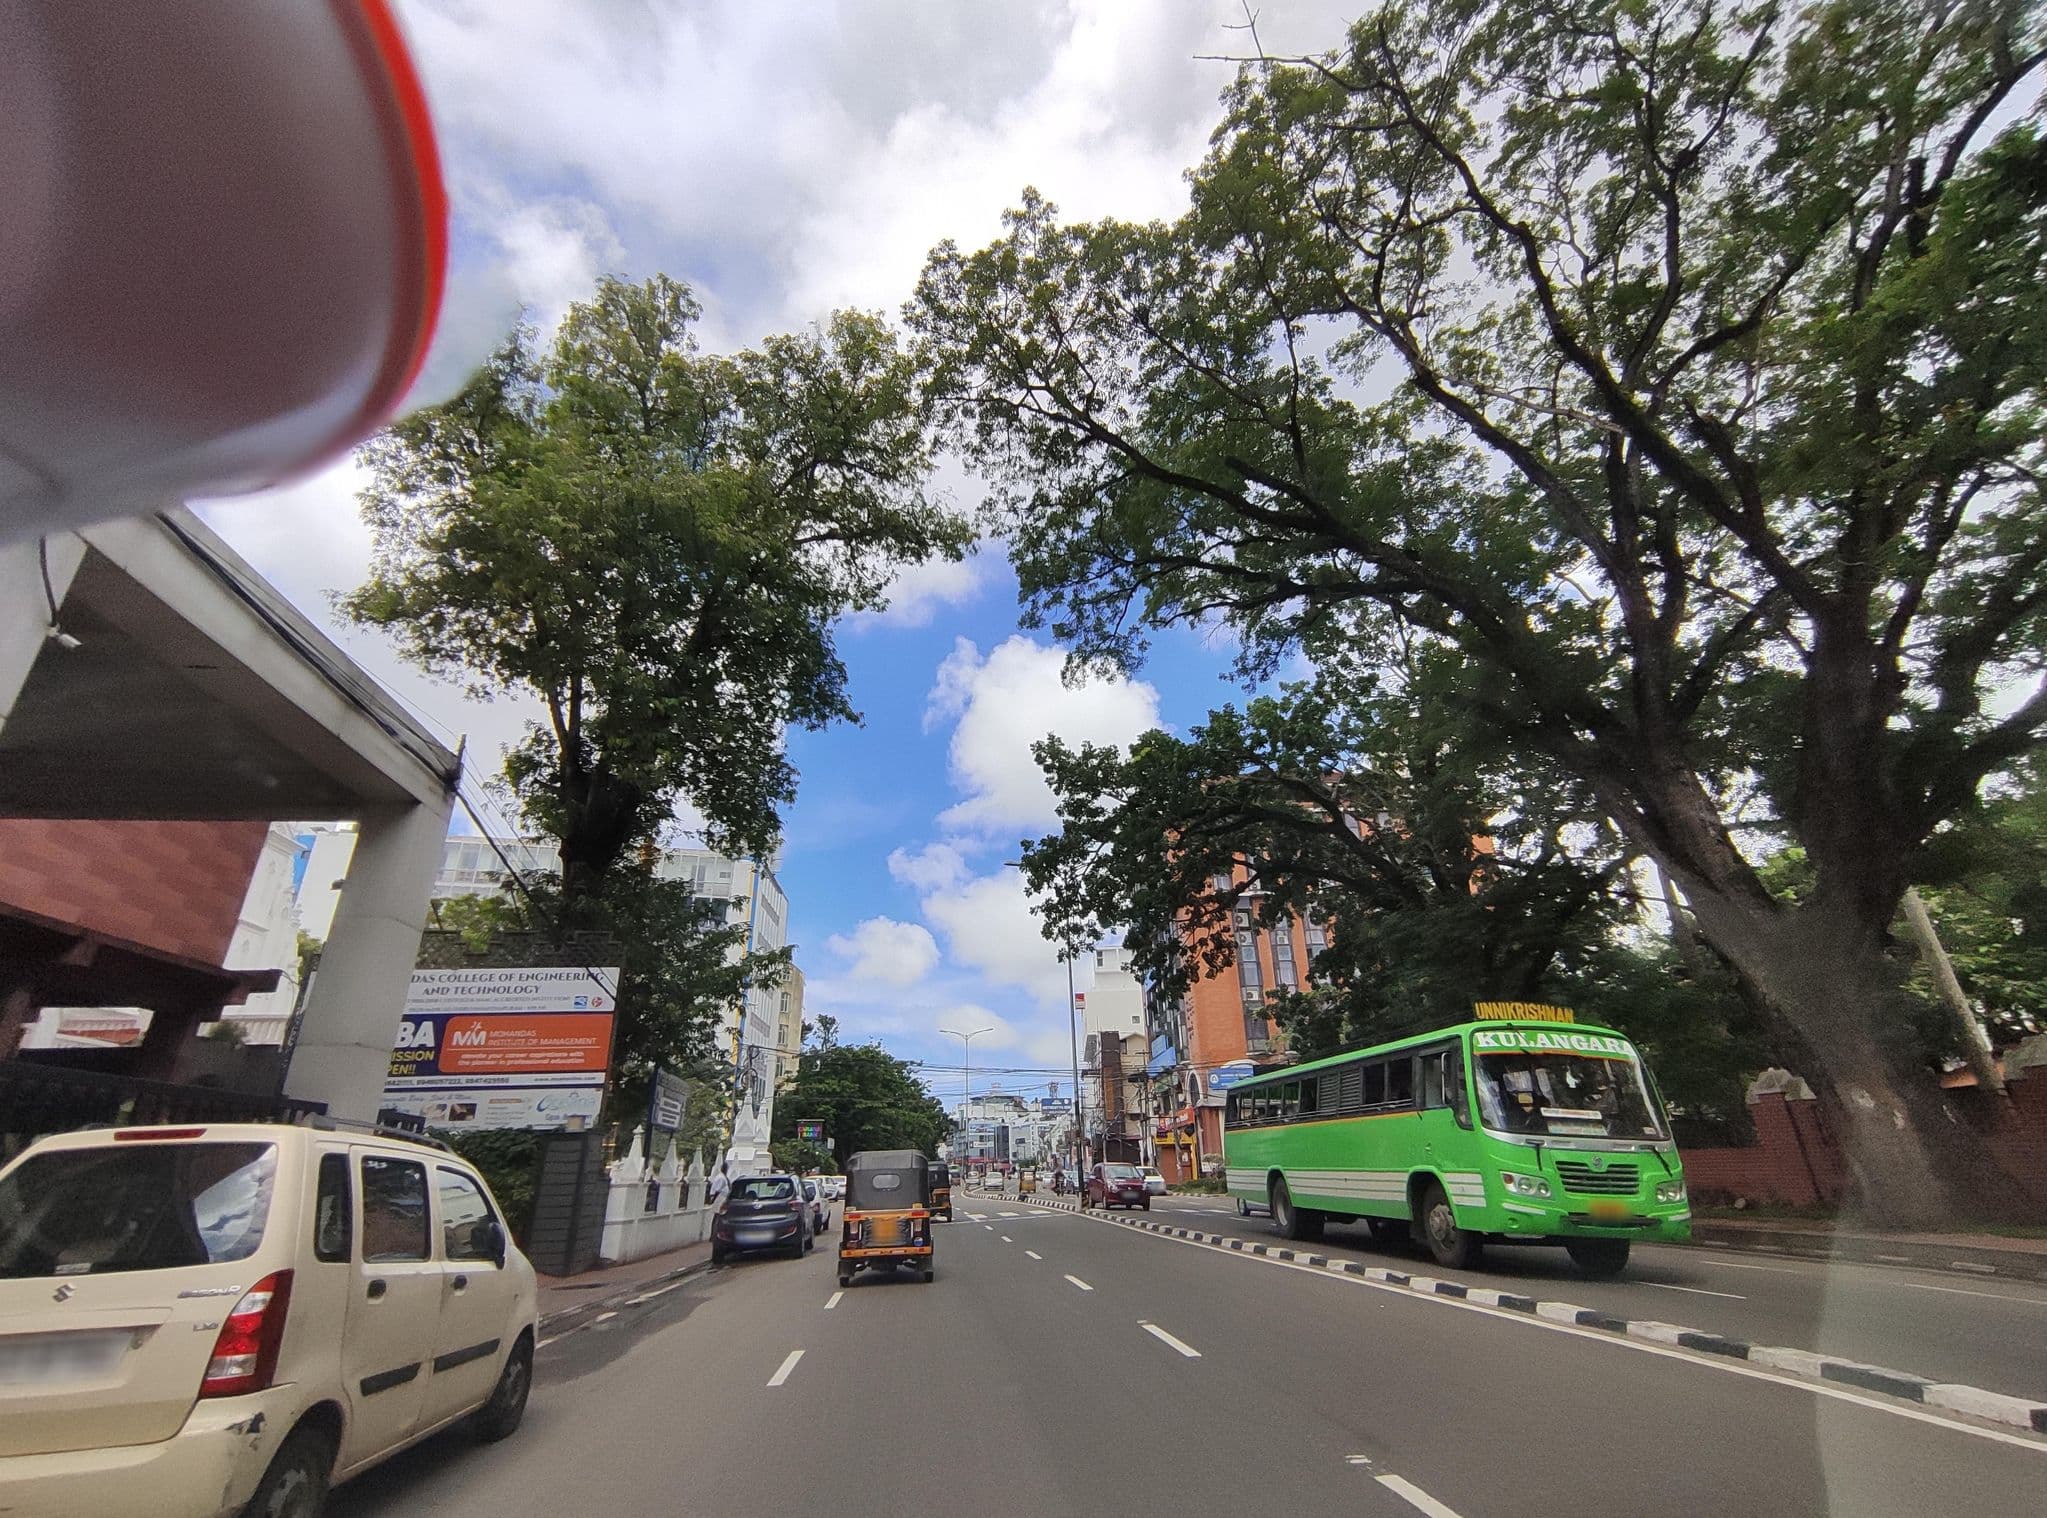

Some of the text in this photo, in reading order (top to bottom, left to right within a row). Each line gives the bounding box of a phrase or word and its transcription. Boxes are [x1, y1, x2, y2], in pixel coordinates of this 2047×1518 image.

[411, 972, 604, 984] DAS COLLEGE OF ENGINEERING
[422, 985, 541, 996] AND TECHNOLOGY
[1474, 1002, 1574, 1023] UNNIKRISHNAN
[489, 1029, 537, 1038] MOHANDAS
[527, 1038, 538, 1046] OF
[540, 1037, 597, 1046] MANAGEMENT
[1476, 1031, 1633, 1054] KULANGARA
